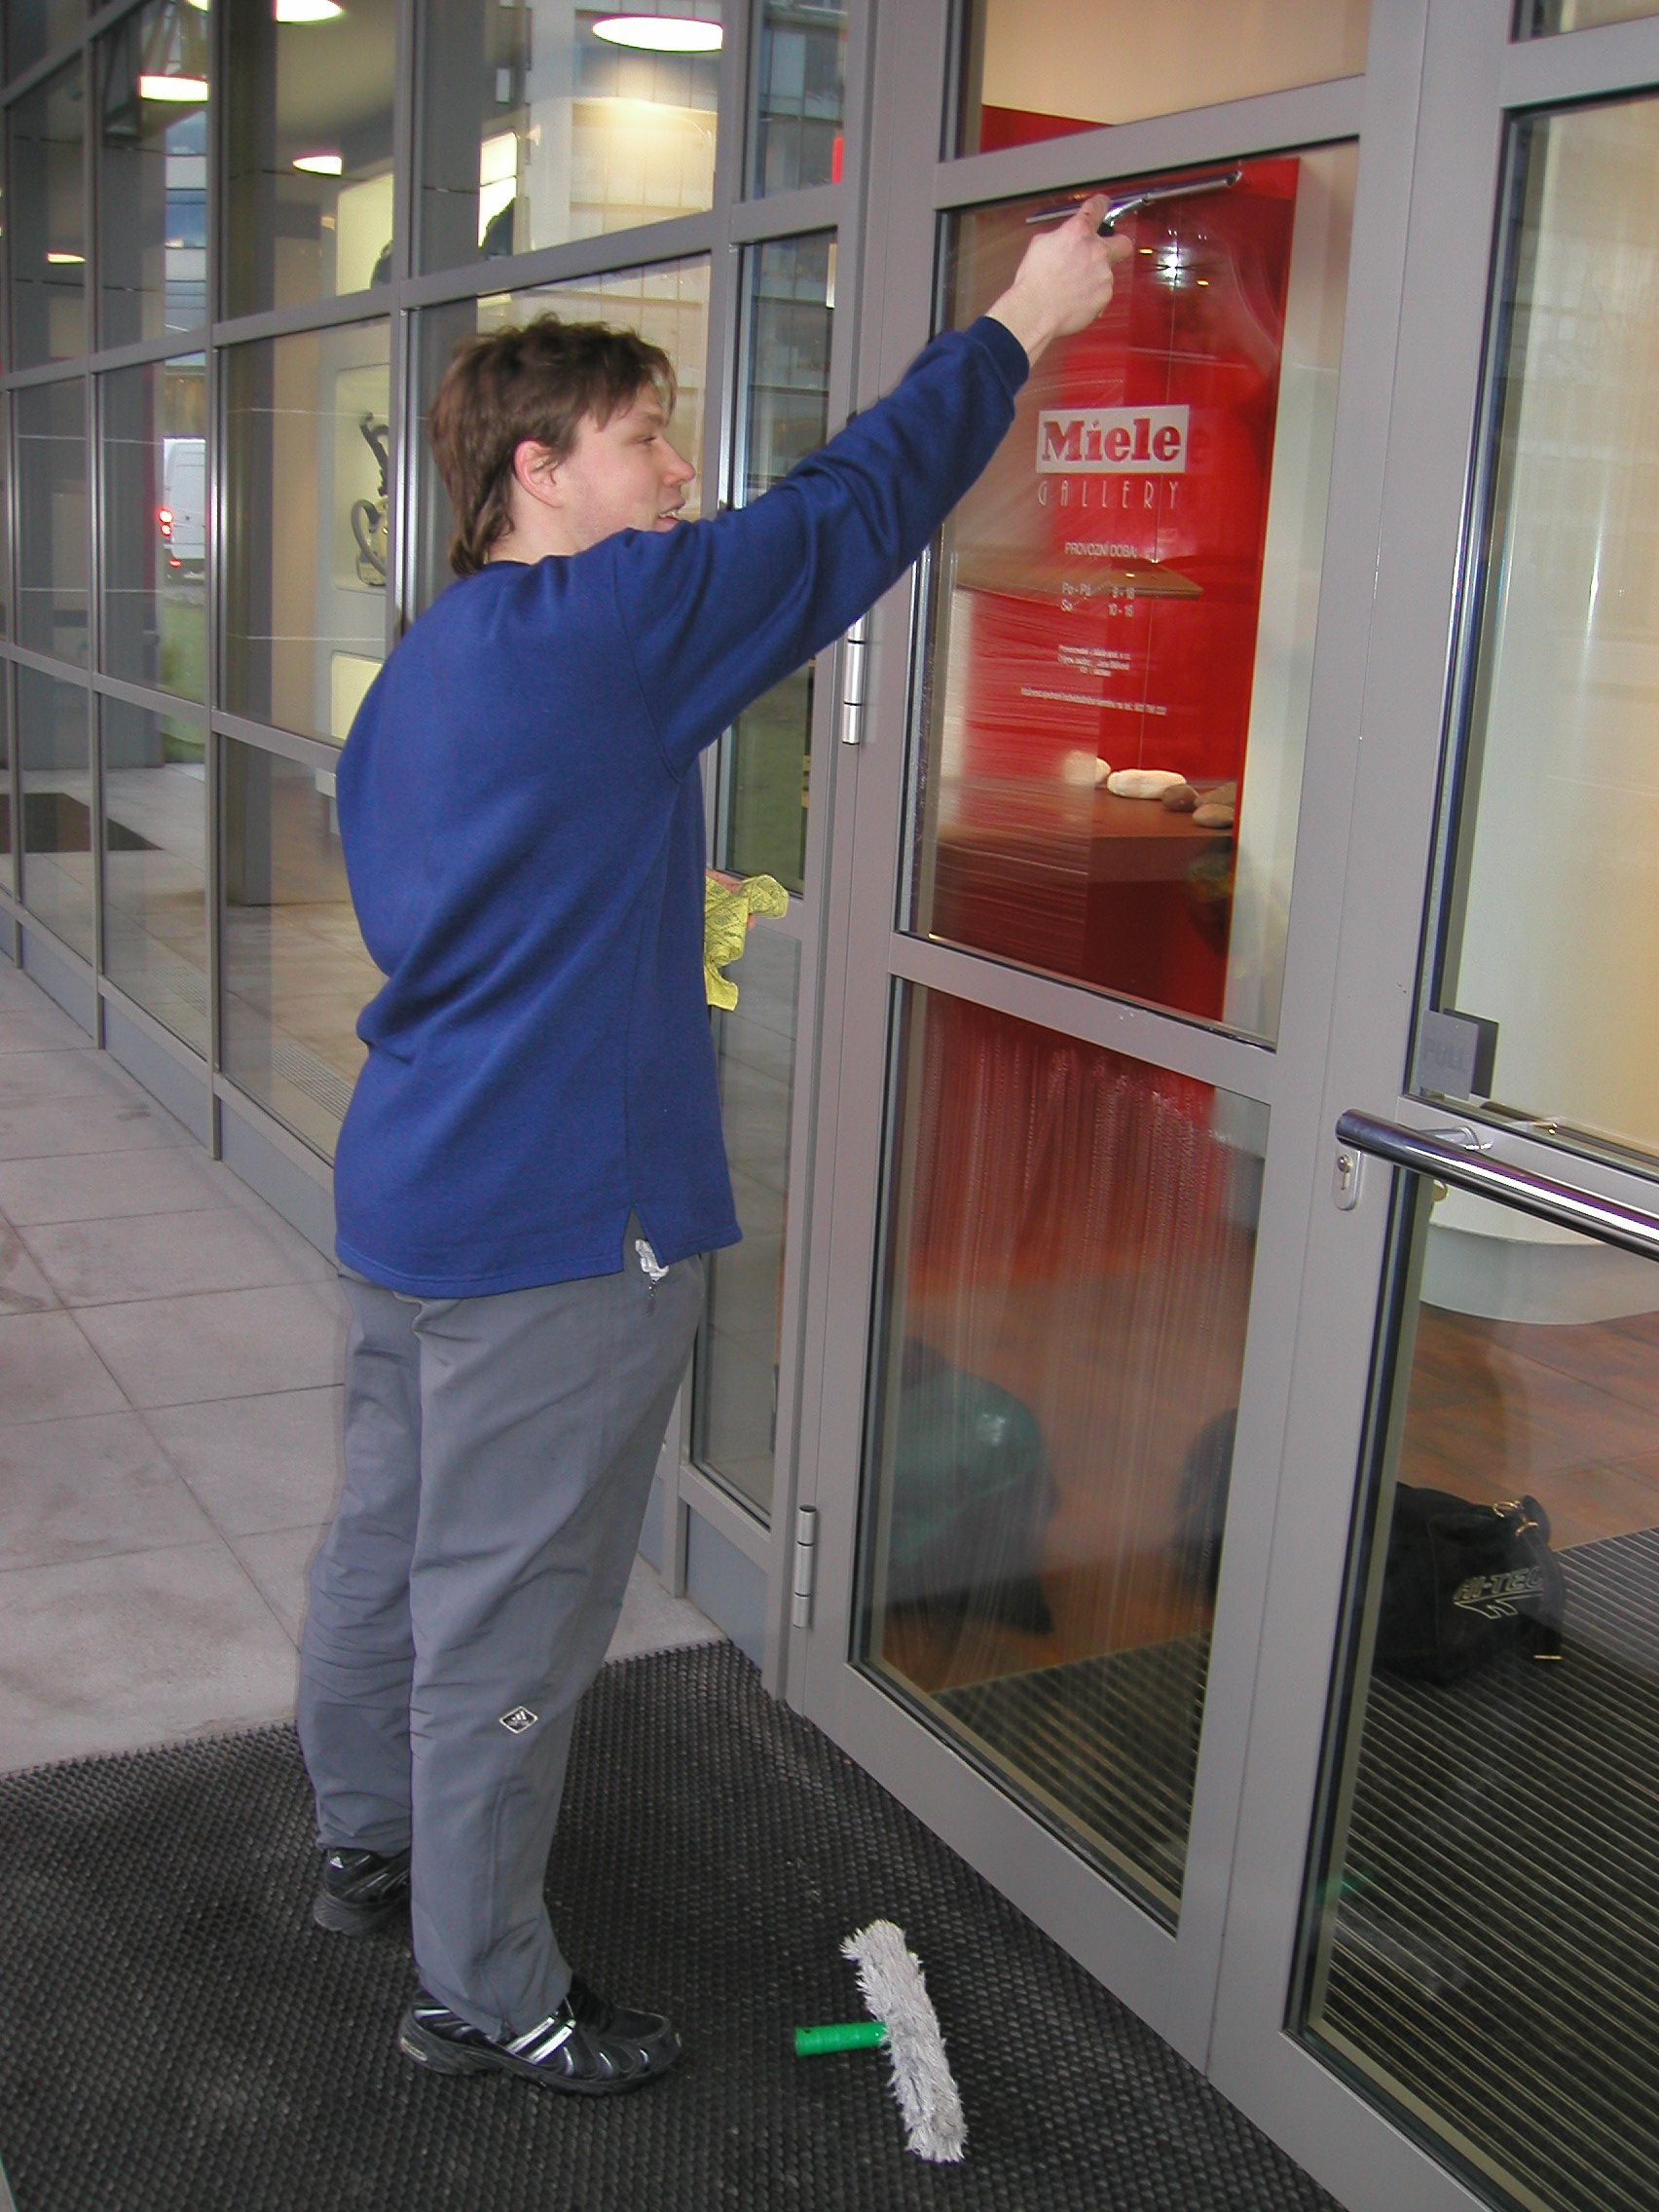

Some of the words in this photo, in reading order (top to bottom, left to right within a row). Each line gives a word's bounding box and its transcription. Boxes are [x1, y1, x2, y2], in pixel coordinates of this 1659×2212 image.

[1041, 418, 1182, 462] Miele
[1037, 480, 1179, 509] GALLERY
[1064, 540, 1108, 556] PROVOZNÍ
[1453, 1565, 1544, 1601] HI-TEC
